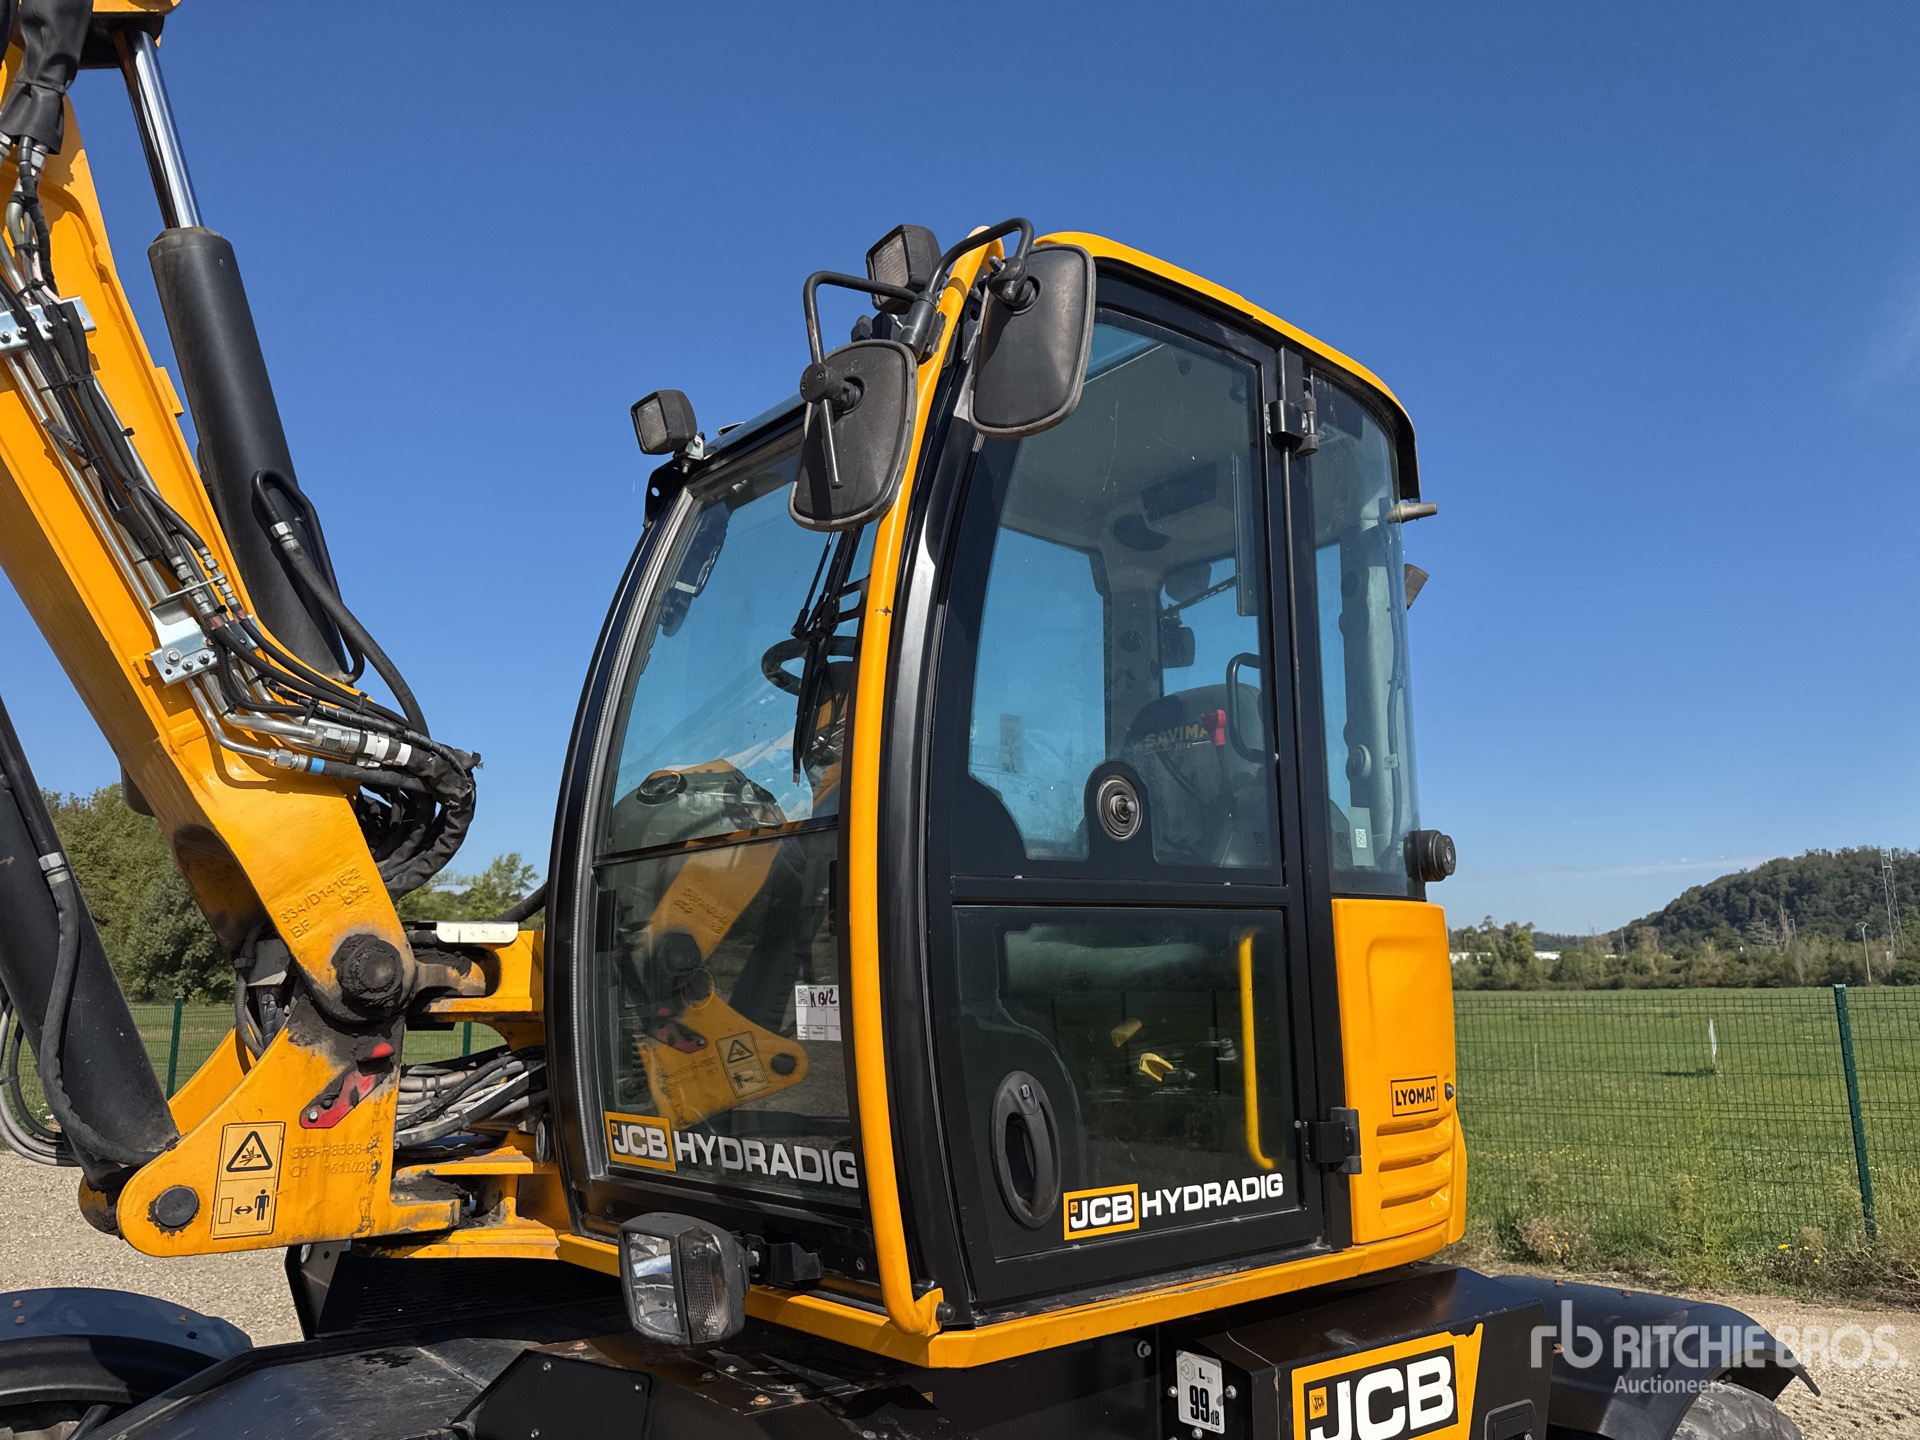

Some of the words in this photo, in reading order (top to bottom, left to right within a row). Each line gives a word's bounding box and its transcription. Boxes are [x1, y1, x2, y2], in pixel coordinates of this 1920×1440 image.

[1395, 1086, 1436, 1106] LYOMAT
[613, 1124, 668, 1158] JCB
[673, 1131, 859, 1188] HYDRADIG
[1070, 1194, 1133, 1229] JCB
[1142, 1173, 1284, 1218] HYDRADIG
[1309, 1355, 1454, 1440] JCB
